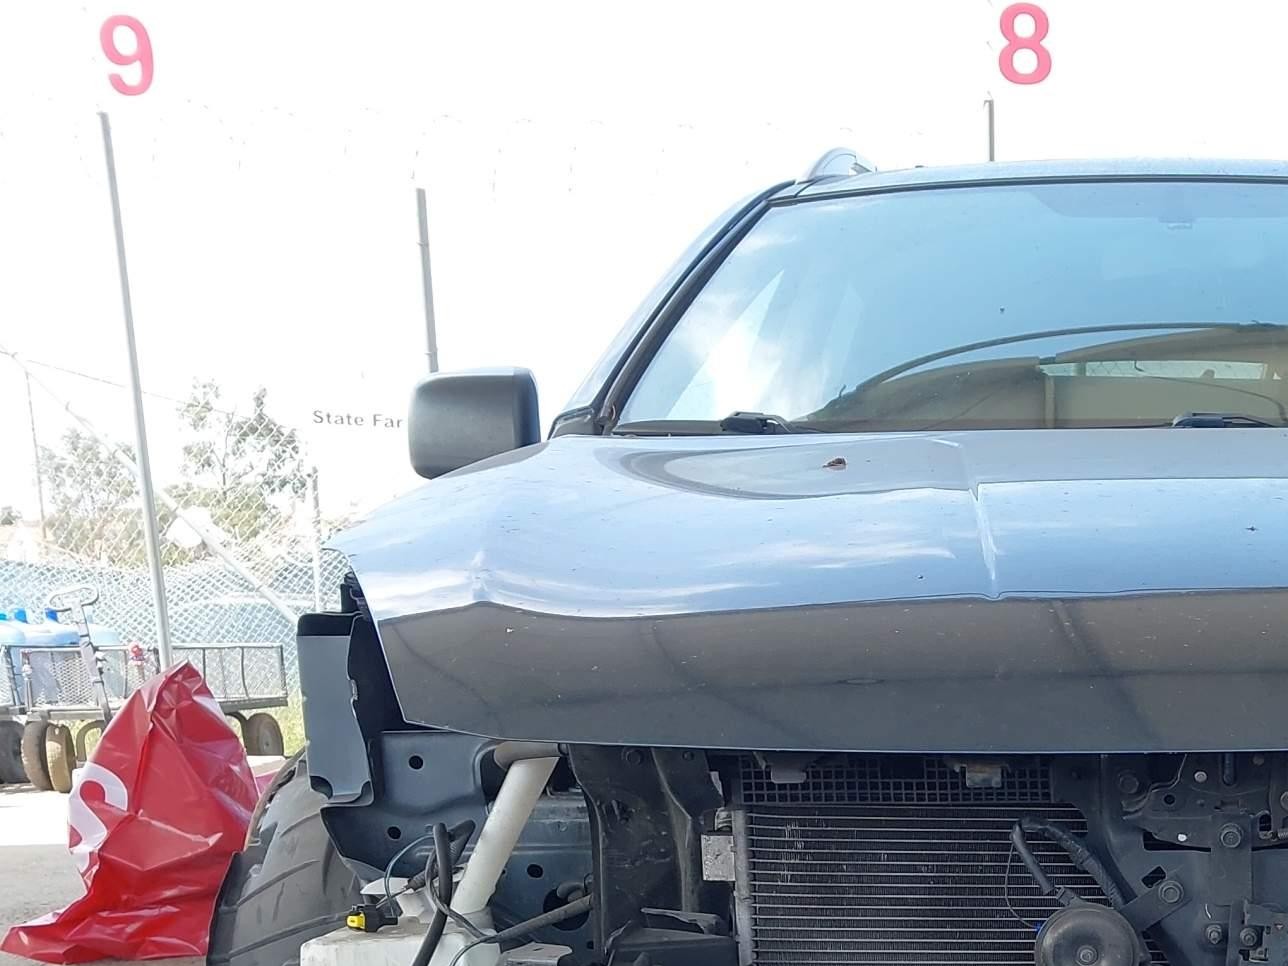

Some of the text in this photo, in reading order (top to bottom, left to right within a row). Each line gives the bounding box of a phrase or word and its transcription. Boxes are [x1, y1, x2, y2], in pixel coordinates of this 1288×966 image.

[100, 15, 154, 96] 9
[998, 3, 1053, 85] 8
[312, 409, 364, 426] State
